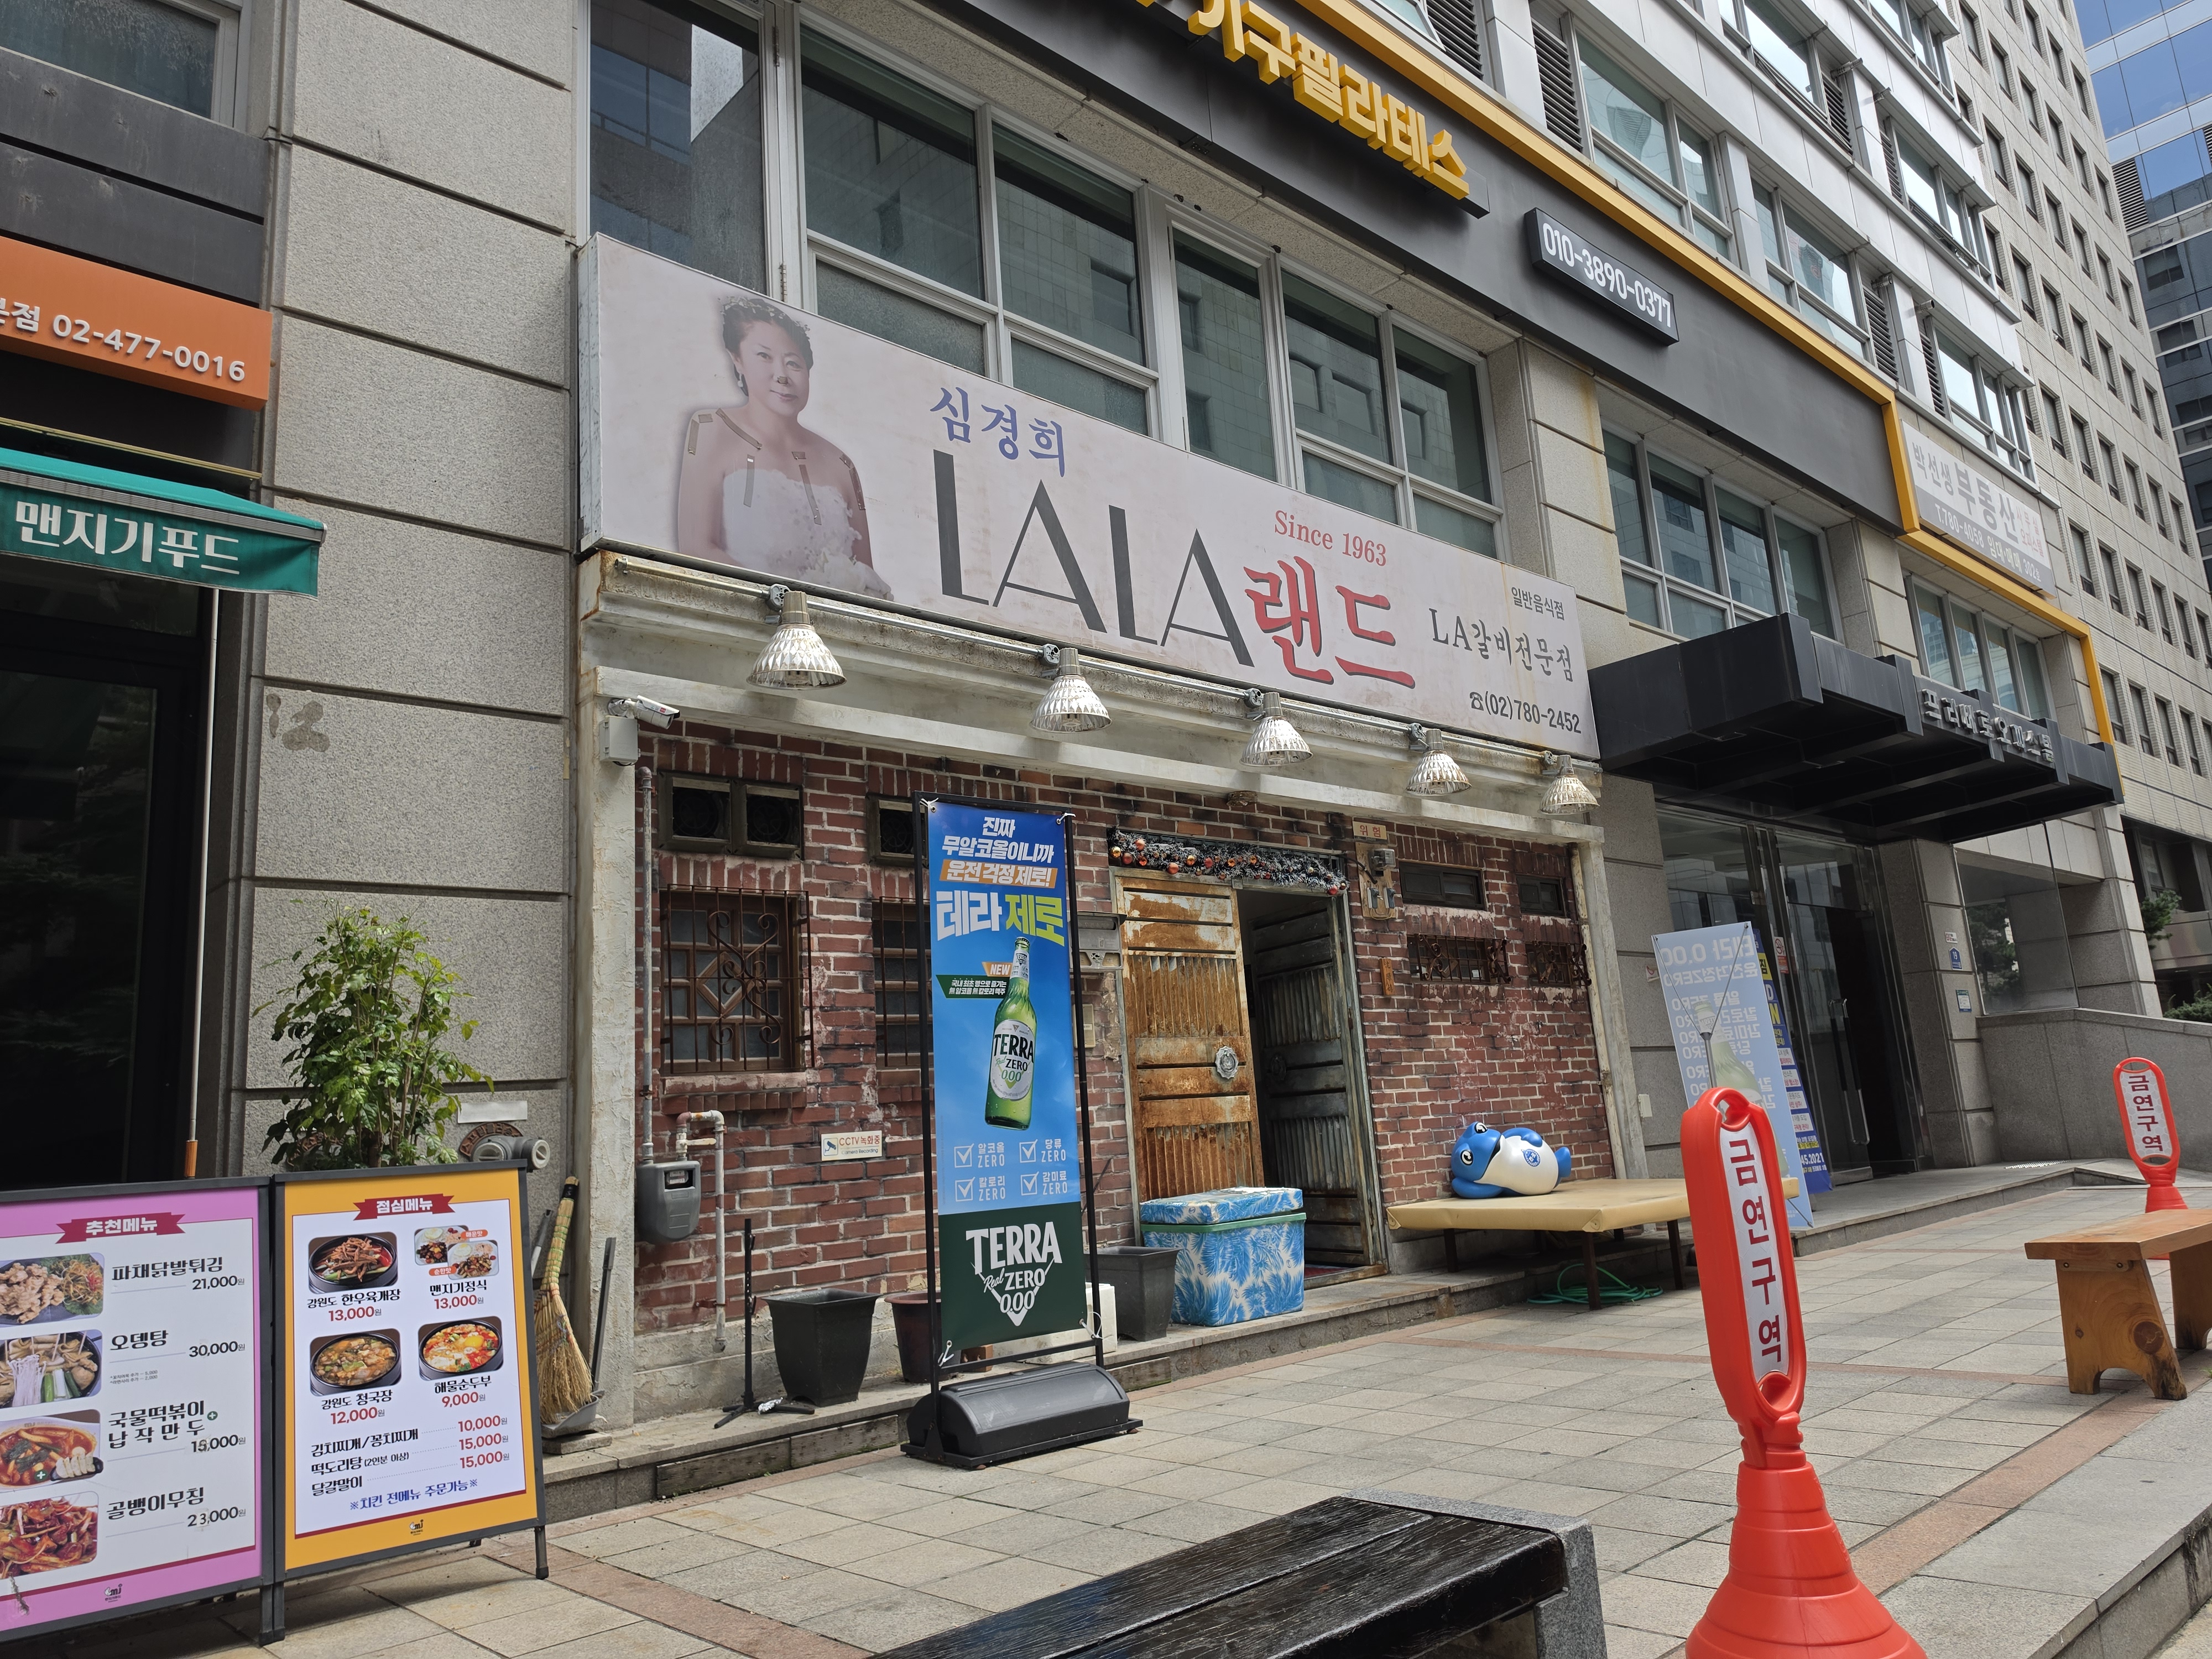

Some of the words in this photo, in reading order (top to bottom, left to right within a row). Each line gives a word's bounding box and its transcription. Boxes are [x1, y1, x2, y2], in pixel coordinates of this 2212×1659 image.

[1542, 222, 1672, 329] 010-3890-0377
[53, 314, 245, 382] 02-477-0016
[930, 387, 1065, 478] 심경희
[1912, 442, 1954, 496] 박선생
[1954, 462, 2019, 544] 부동산
[15, 500, 239, 575] 맨지기푸드
[1274, 510, 1333, 550] Since
[1342, 533, 1387, 567] 1963
[1935, 503, 1985, 549] T.780-4058
[2023, 559, 2042, 582] 302호
[1511, 586, 1566, 620] 일반음식점
[1429, 608, 1573, 682] LA갈비전문점
[982, 816, 1016, 838] 진짜
[942, 835, 1054, 863] 무알코올이니까
[936, 890, 1003, 941] 테라
[1005, 894, 1065, 947] 제로
[990, 964, 1011, 975] NEW
[994, 1034, 1034, 1063] TERRA
[1005, 1058, 1028, 1071] ZERO
[1001, 1070, 1021, 1082] 0.00
[2128, 1075, 2163, 1152] 금연구역
[839, 1136, 859, 1146] CCTV
[860, 1135, 880, 1145] 녹화중
[978, 1142, 1005, 1155] 알코올
[1045, 1139, 1062, 1149] 당류
[977, 1154, 1005, 1168] ZERO
[1041, 1149, 1066, 1162] ZERO
[979, 1175, 1005, 1188] 칼로리
[1042, 1171, 1067, 1182] 감미료
[979, 1187, 1006, 1201] ZERO
[1042, 1182, 1068, 1195] ZERO
[377, 1197, 432, 1214] 점심메뉴
[86, 1217, 158, 1235] 추천메뉴
[966, 1222, 1063, 1275] TERRA
[1729, 1138, 1782, 1363] 금연구역
[111, 1257, 223, 1281] 파채닭발튀김
[983, 1267, 1005, 1293] Real
[1004, 1268, 1045, 1291] ZERO
[192, 1275, 245, 1291] 21,000원
[430, 1280, 487, 1296] 맨지기정식
[307, 1297, 337, 1309] 강원도
[341, 1288, 401, 1306] 한우육개장
[434, 1295, 484, 1310] 13,000원
[1000, 1290, 1036, 1313] 0.00
[328, 1306, 382, 1322] 13,000원
[109, 1330, 169, 1351] 오뎅탕
[189, 1341, 246, 1358] 30,000원
[435, 1375, 492, 1394] 해물순두부
[321, 1396, 352, 1410] 강원도
[356, 1389, 393, 1406] 청국장
[442, 1391, 486, 1408] 9,000원
[108, 1400, 205, 1428] 국물떡볶이
[331, 1407, 385, 1425] 12,000원
[311, 1428, 419, 1457] 김치찌개/꽁치찌개
[458, 1415, 508, 1432] 10,000원
[311, 1457, 363, 1475] 떡도리탕
[364, 1455, 388, 1467] (2인분
[391, 1452, 409, 1463] 이상)
[459, 1433, 509, 1451] 15,000원
[311, 1476, 363, 1496] 달걀말이
[460, 1451, 510, 1469] 15,000원
[107, 1487, 205, 1520] 골뱅이무침
[387, 1489, 421, 1505] 전메뉴
[187, 1506, 246, 1527] 23,000원
